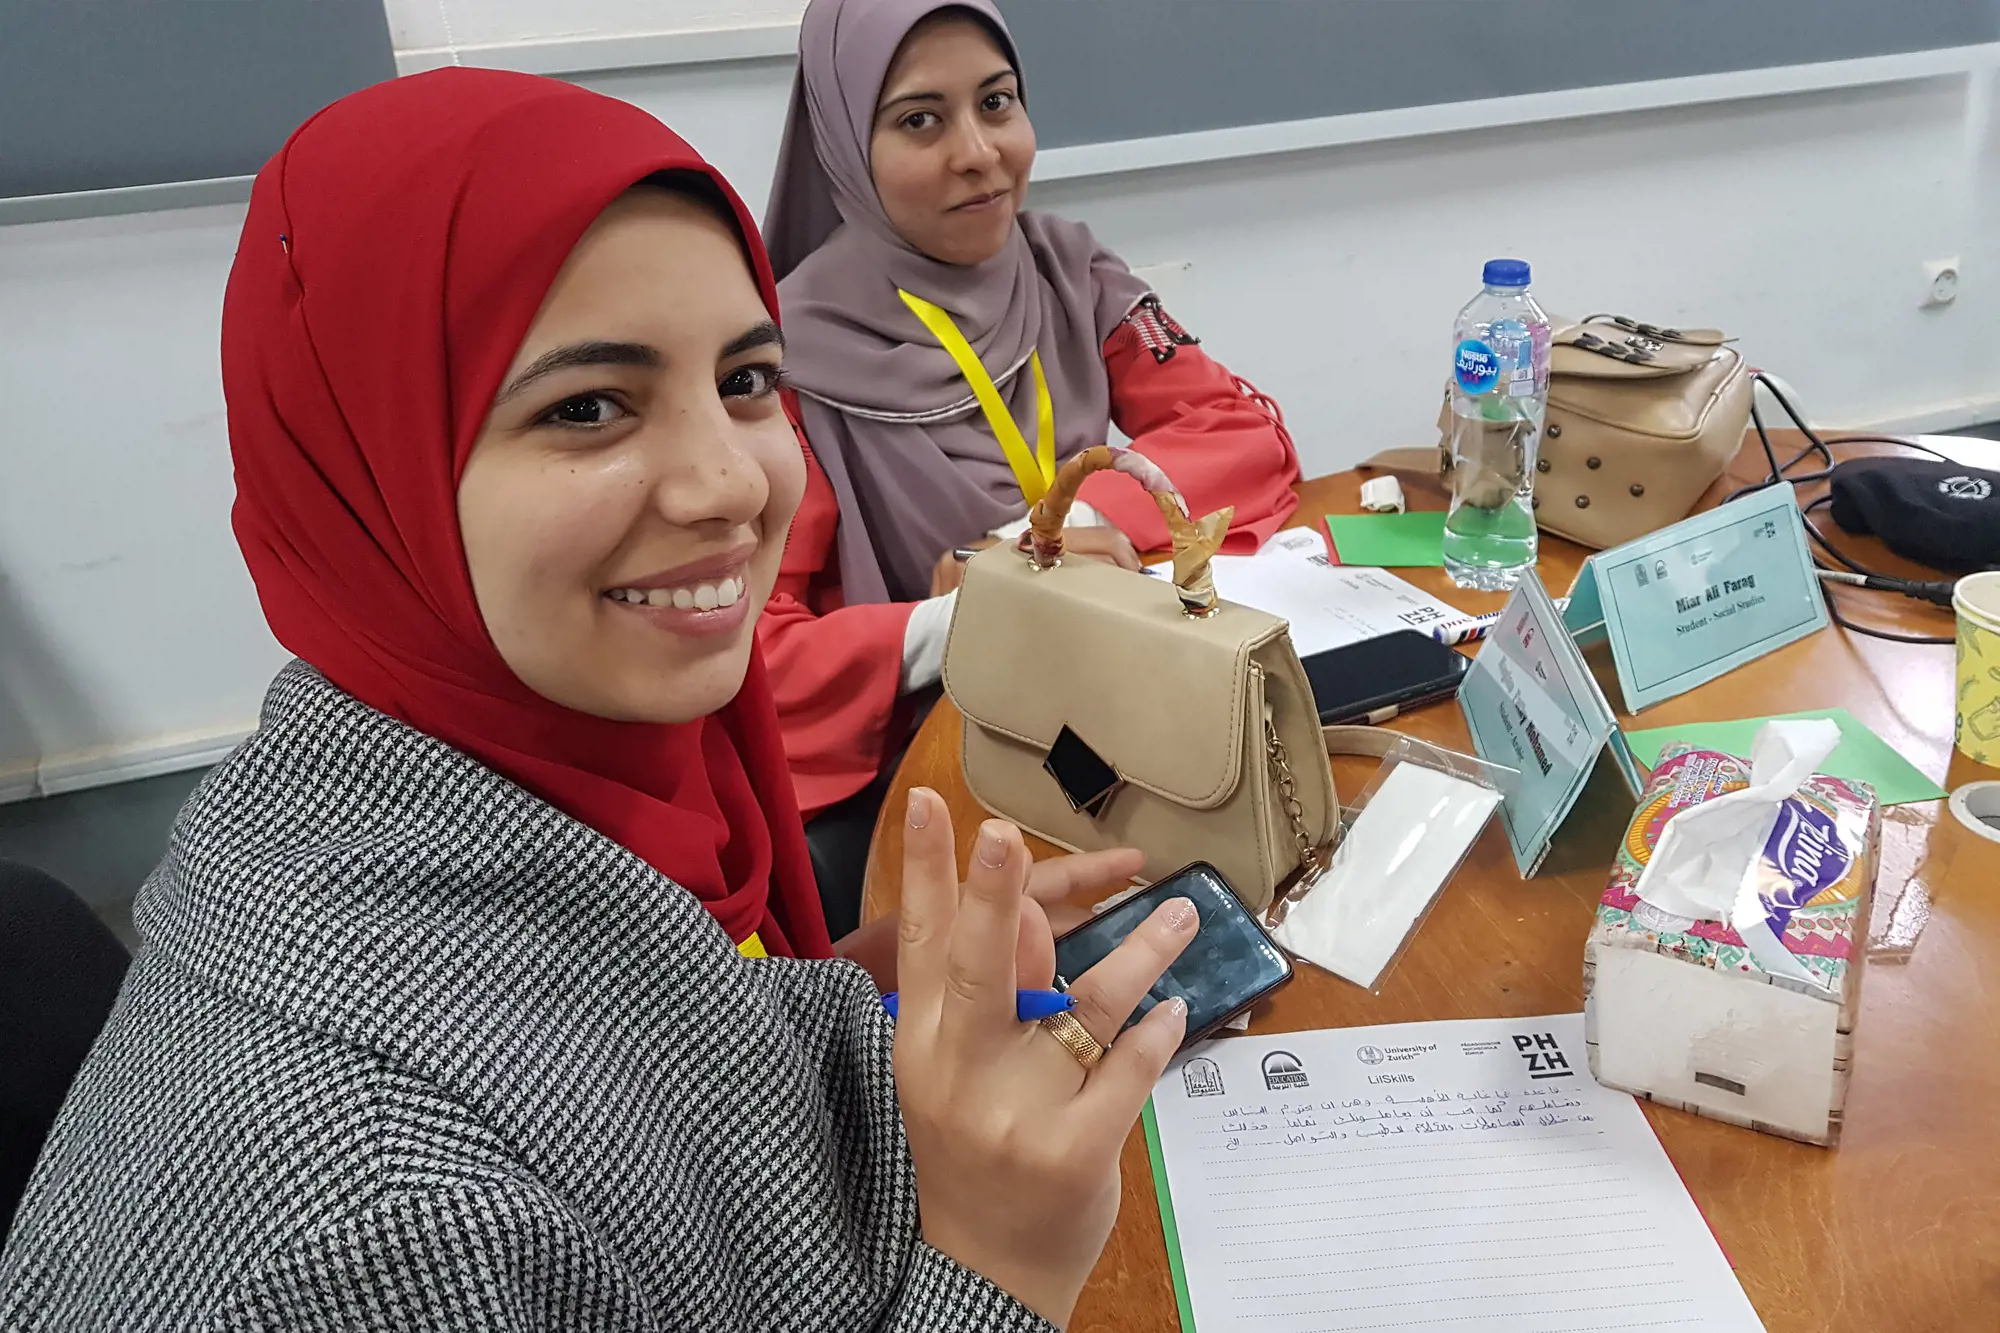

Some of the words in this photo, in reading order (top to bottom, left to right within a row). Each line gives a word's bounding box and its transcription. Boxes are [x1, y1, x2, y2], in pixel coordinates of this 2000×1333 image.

[1676, 594, 1701, 613] Miar
[1705, 584, 1721, 602] Ali
[1724, 574, 1756, 594] Farag
[1676, 616, 1707, 637] Student
[1713, 604, 1736, 620] Social
[1737, 595, 1766, 611] Studies
[1526, 720, 1553, 777] Mohamed
[1384, 1045, 1425, 1056] University
[1426, 1044, 1437, 1052] of
[1511, 1033, 1559, 1052] PH
[1387, 1053, 1414, 1061] Zurich
[1521, 1052, 1571, 1071] ZH
[1268, 1073, 1308, 1084] EDUCATION
[1368, 1073, 1415, 1085] LilSkills
